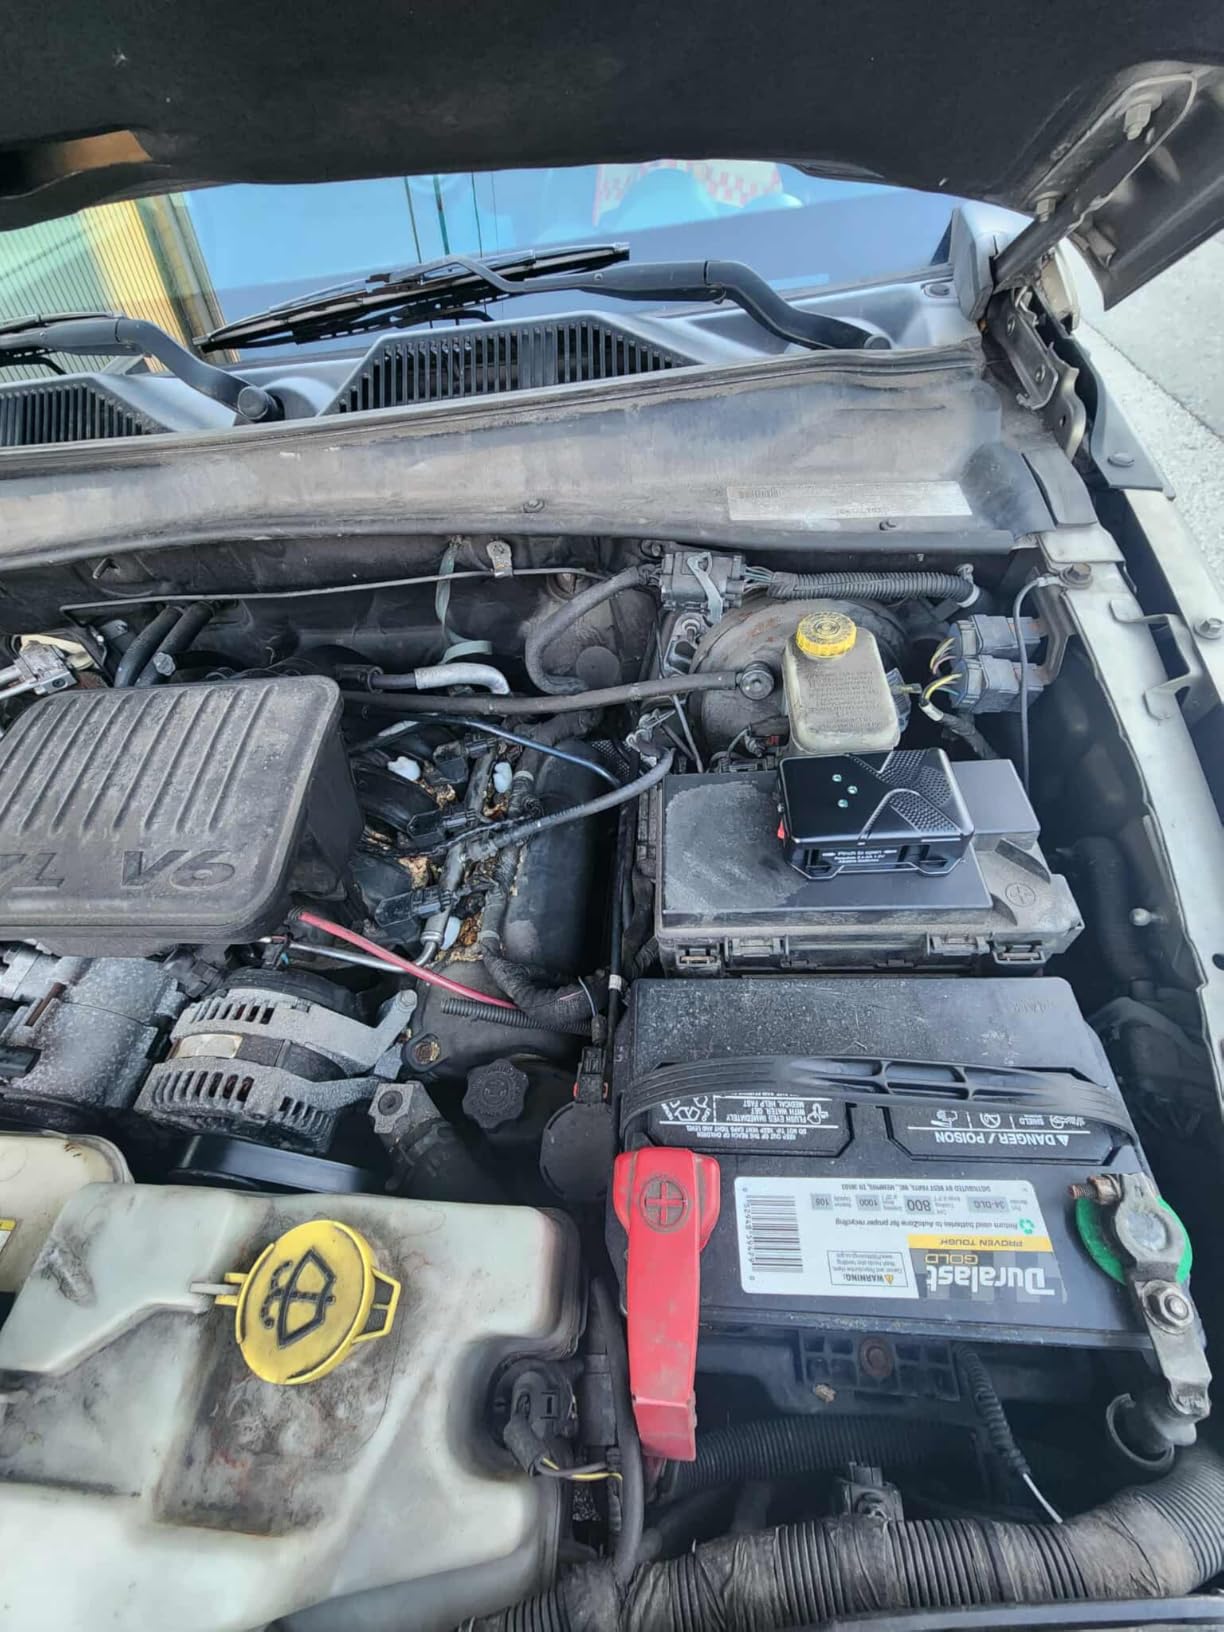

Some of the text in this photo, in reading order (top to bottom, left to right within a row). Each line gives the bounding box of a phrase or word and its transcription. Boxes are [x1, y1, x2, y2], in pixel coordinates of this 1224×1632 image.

[121, 850, 236, 889] V6
[934, 1131, 986, 1143] POISON
[998, 1133, 1056, 1145] DANGER
[859, 1199, 878, 1207] 1000
[906, 1199, 931, 1212] 800
[940, 1238, 1022, 1248] PROVEN TOUGH
[925, 1253, 978, 1264] GOLD
[926, 1265, 1055, 1296] Duralast
